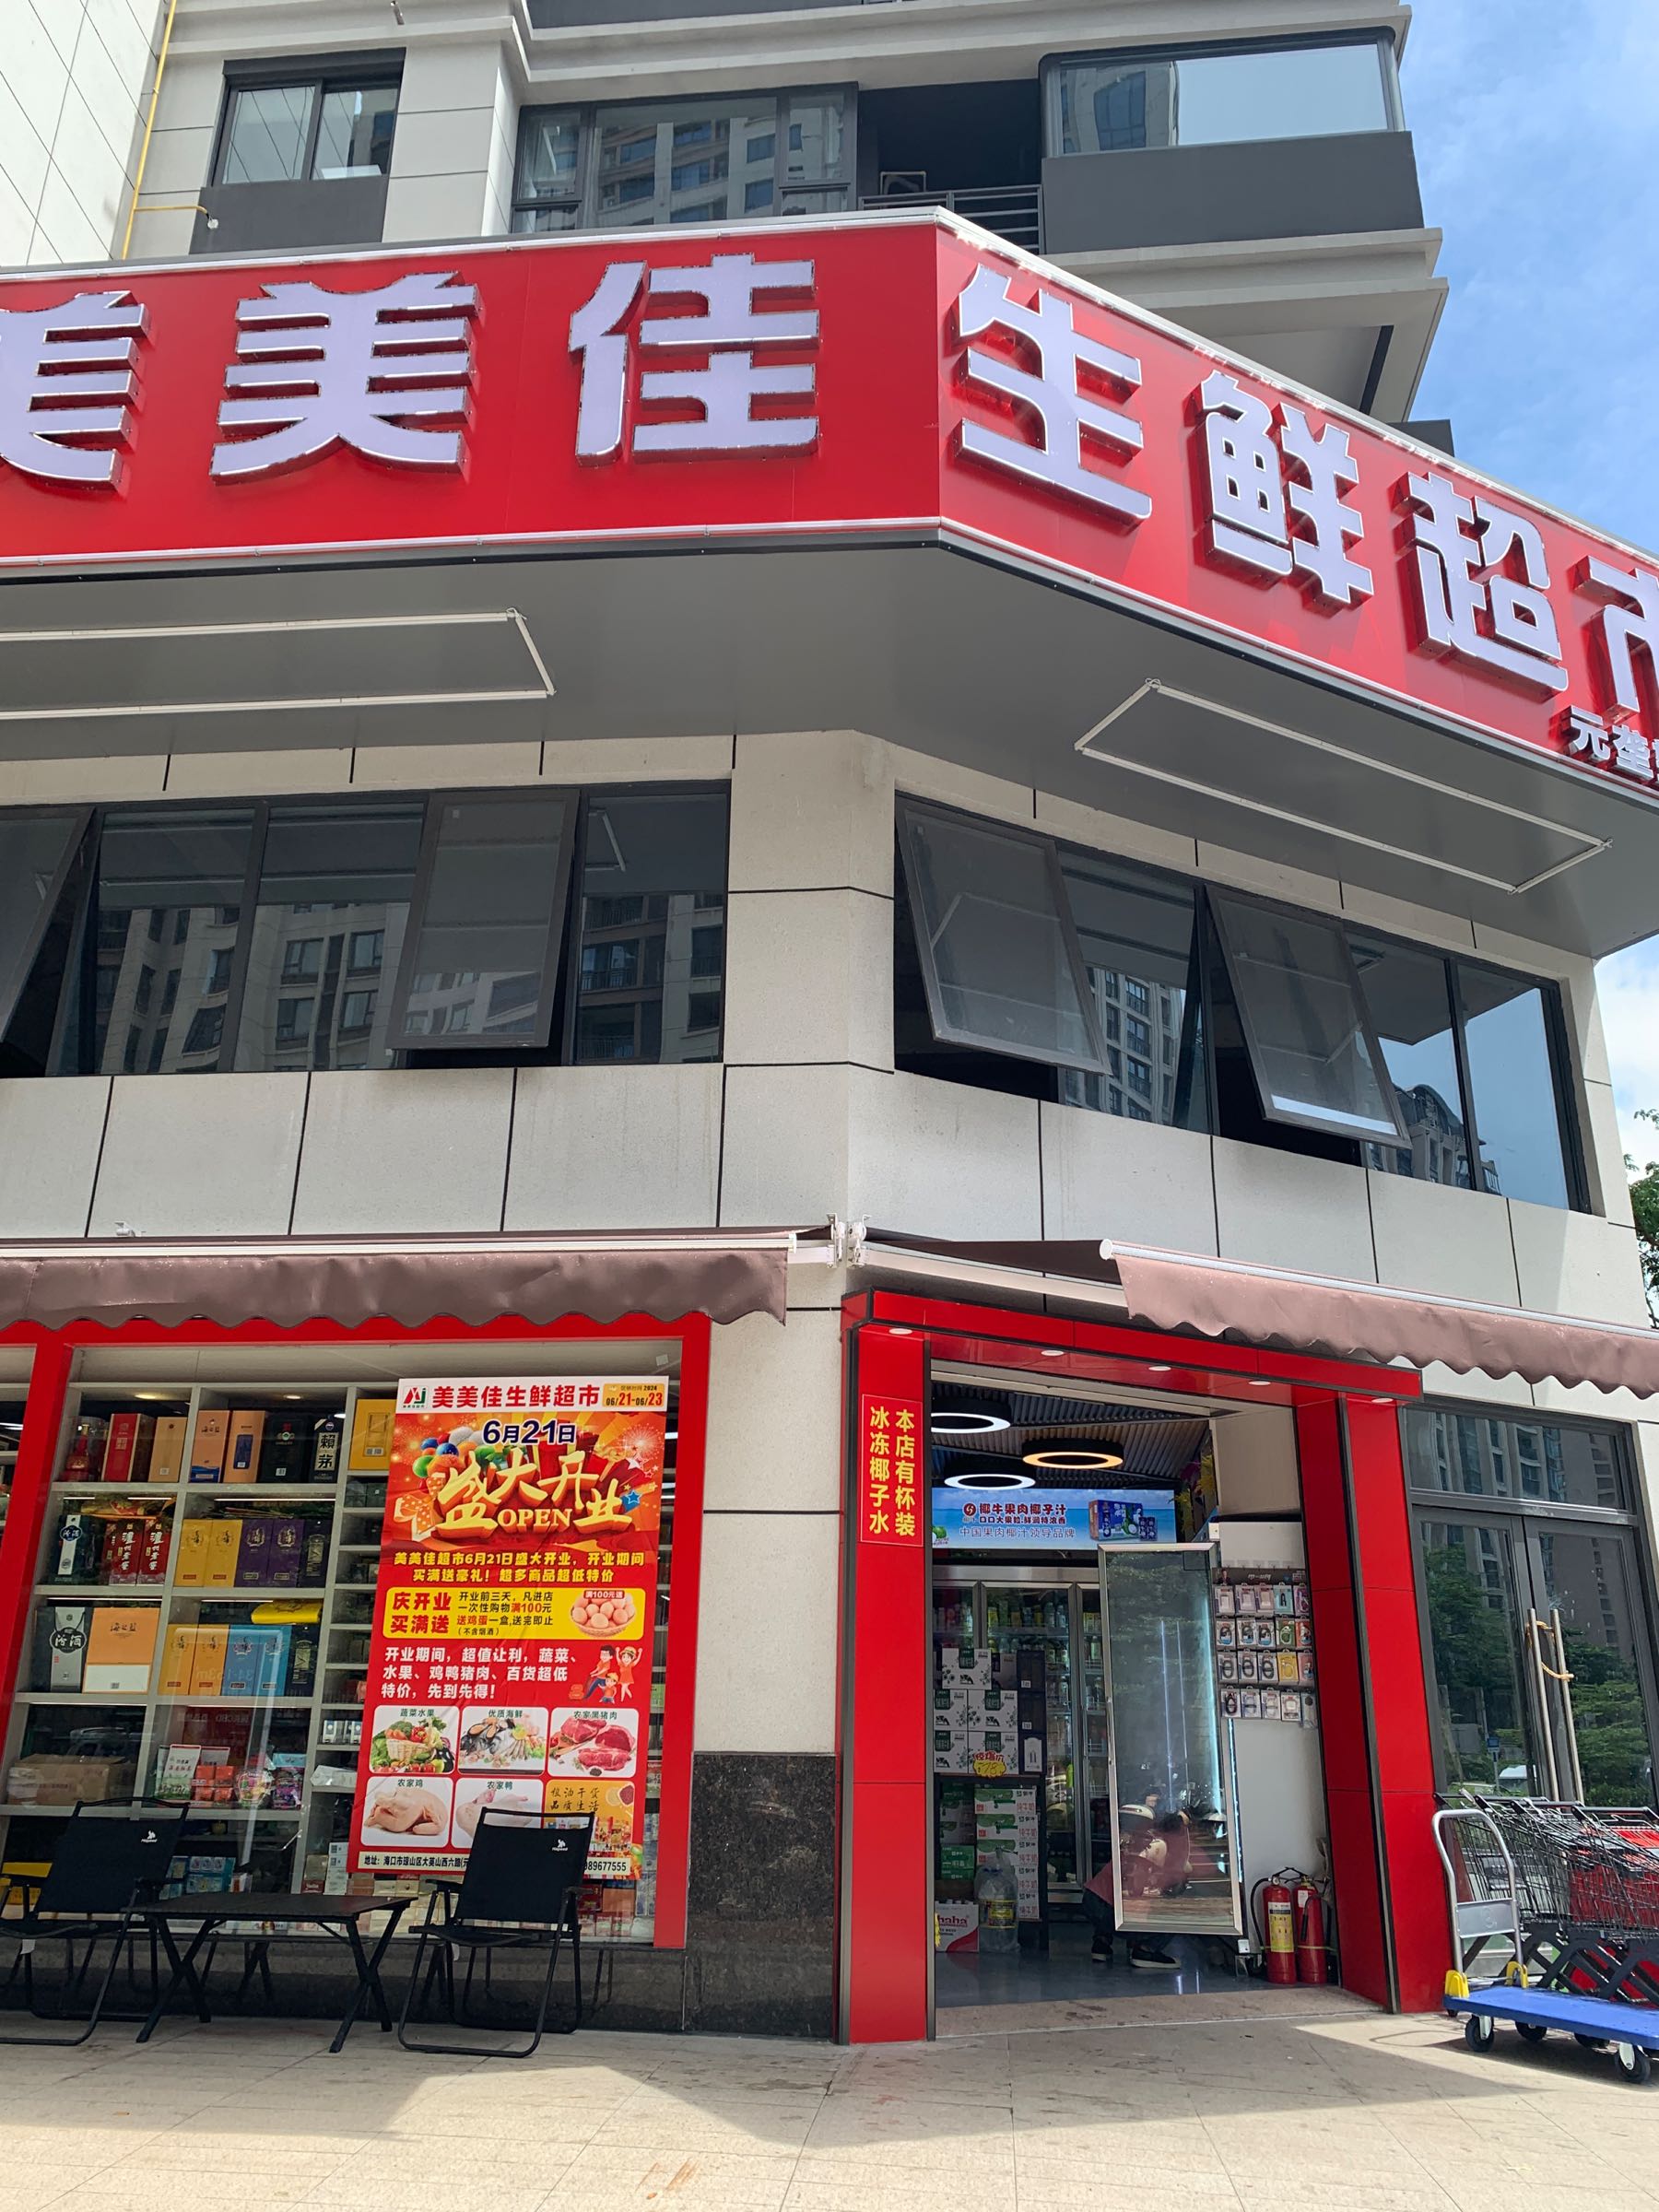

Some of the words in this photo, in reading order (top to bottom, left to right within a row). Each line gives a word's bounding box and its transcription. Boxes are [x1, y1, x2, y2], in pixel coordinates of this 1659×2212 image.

[1568, 704, 1659, 783] 元垄
[432, 1385, 600, 1408] 美美佳生鲜超市
[606, 1393, 663, 1406] 06/21-06/23
[483, 1419, 576, 1444] 6月21日
[869, 1406, 889, 1535] 冰冻椰子水
[895, 1408, 915, 1537] 本店有杯装
[436, 1447, 633, 1535] 盛大开业
[497, 1508, 573, 1528] OPEN
[979, 1503, 1066, 1516] 椰牛果肉椰子汁
[393, 1592, 452, 1611] 庆开业
[458, 1603, 552, 1613] 一次性购物满100元
[390, 1615, 450, 1634] 买满送
[384, 1646, 577, 1664] 开业期间，超值让利，蔬菜、
[382, 1665, 568, 1682] 水果、鸡鸭猪肉、百货超低
[381, 1683, 496, 1700] 特价，先到先得！
[488, 1709, 524, 1719] 优质海鲜
[573, 1711, 618, 1720] 农家黑猪肉
[397, 1779, 424, 1788] 农家鸡
